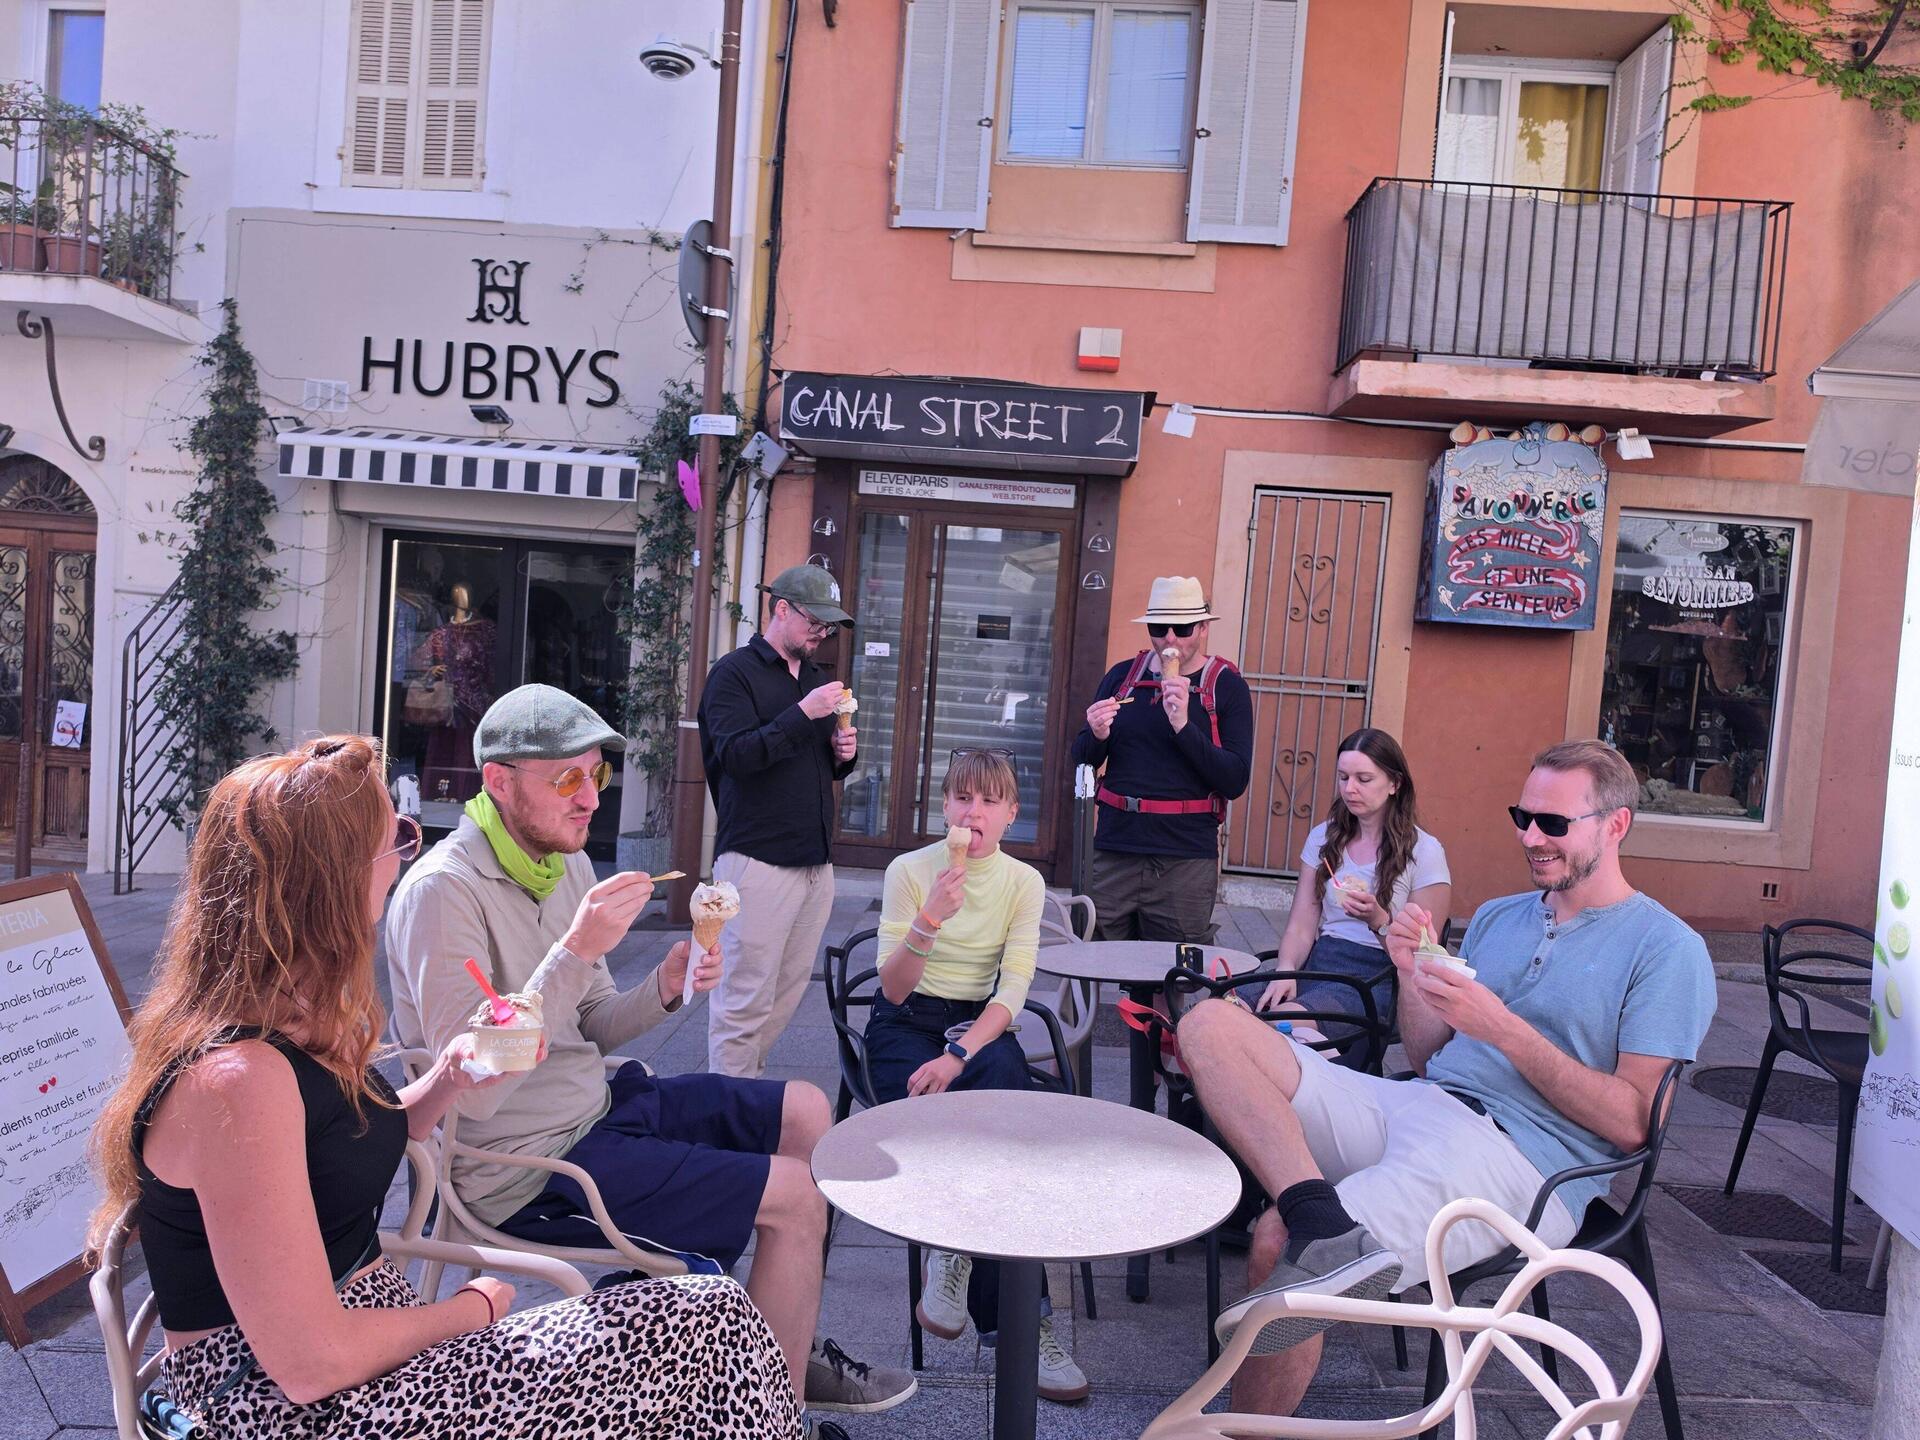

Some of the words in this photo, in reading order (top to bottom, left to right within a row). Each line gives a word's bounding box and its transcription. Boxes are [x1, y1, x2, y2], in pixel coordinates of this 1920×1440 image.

[360, 335, 620, 409] HUBRYS
[789, 386, 905, 432] CANAL
[919, 396, 1085, 444] STREET
[1095, 405, 1129, 447] 2
[141, 466, 166, 475] teddy
[168, 468, 196, 477] smith
[864, 471, 949, 489] ELEVENPARIS
[876, 486, 895, 495] LIFE
[895, 487, 904, 495] IS
[905, 488, 912, 496] A
[912, 488, 936, 498] JOKE
[958, 481, 1072, 495] CANALSTREETBOUTIQUE.COM
[991, 491, 1036, 502] WEB.STORE
[1453, 486, 1597, 520] SAVONNERIE
[1455, 528, 1488, 554] LES
[1498, 528, 1551, 557] MILLE
[1485, 567, 1508, 587] ET
[1514, 567, 1556, 585] UNE
[1663, 563, 1738, 581] ARTISAN
[1478, 591, 1582, 614] SENTEURS
[1641, 575, 1755, 609] SAVONNIER
[32, 946, 85, 975] Glace
[33, 975, 88, 1001] fabriquées
[36, 1027, 80, 1051] familiale
[0, 1115, 33, 1137] dients
[34, 1096, 75, 1122] naturels
[76, 1089, 87, 1102] et
[87, 1080, 112, 1097] fruits
